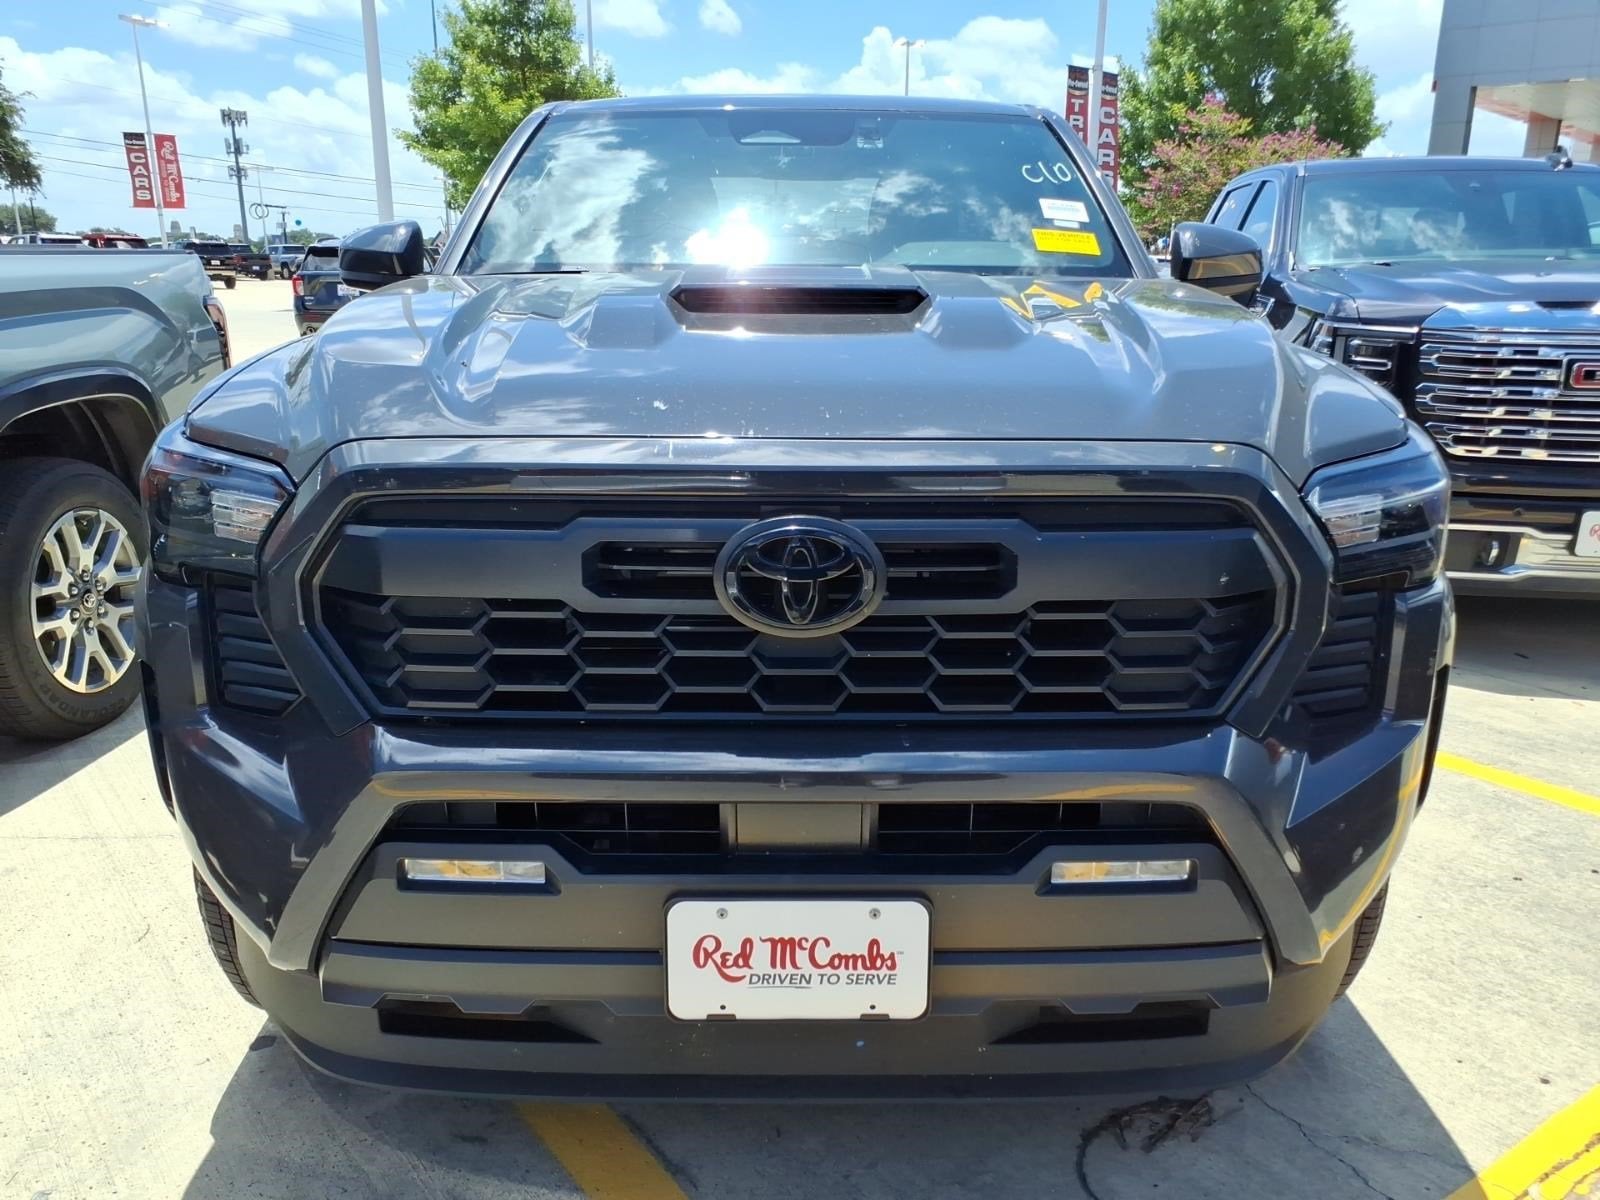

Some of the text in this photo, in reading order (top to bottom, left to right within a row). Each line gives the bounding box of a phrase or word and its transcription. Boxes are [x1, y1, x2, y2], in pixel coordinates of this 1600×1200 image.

[160, 141, 176, 161] Red
[129, 152, 152, 201] CARS
[692, 934, 898, 983] Red McCombs
[748, 973, 898, 986] DRIVEN TO SERVE
